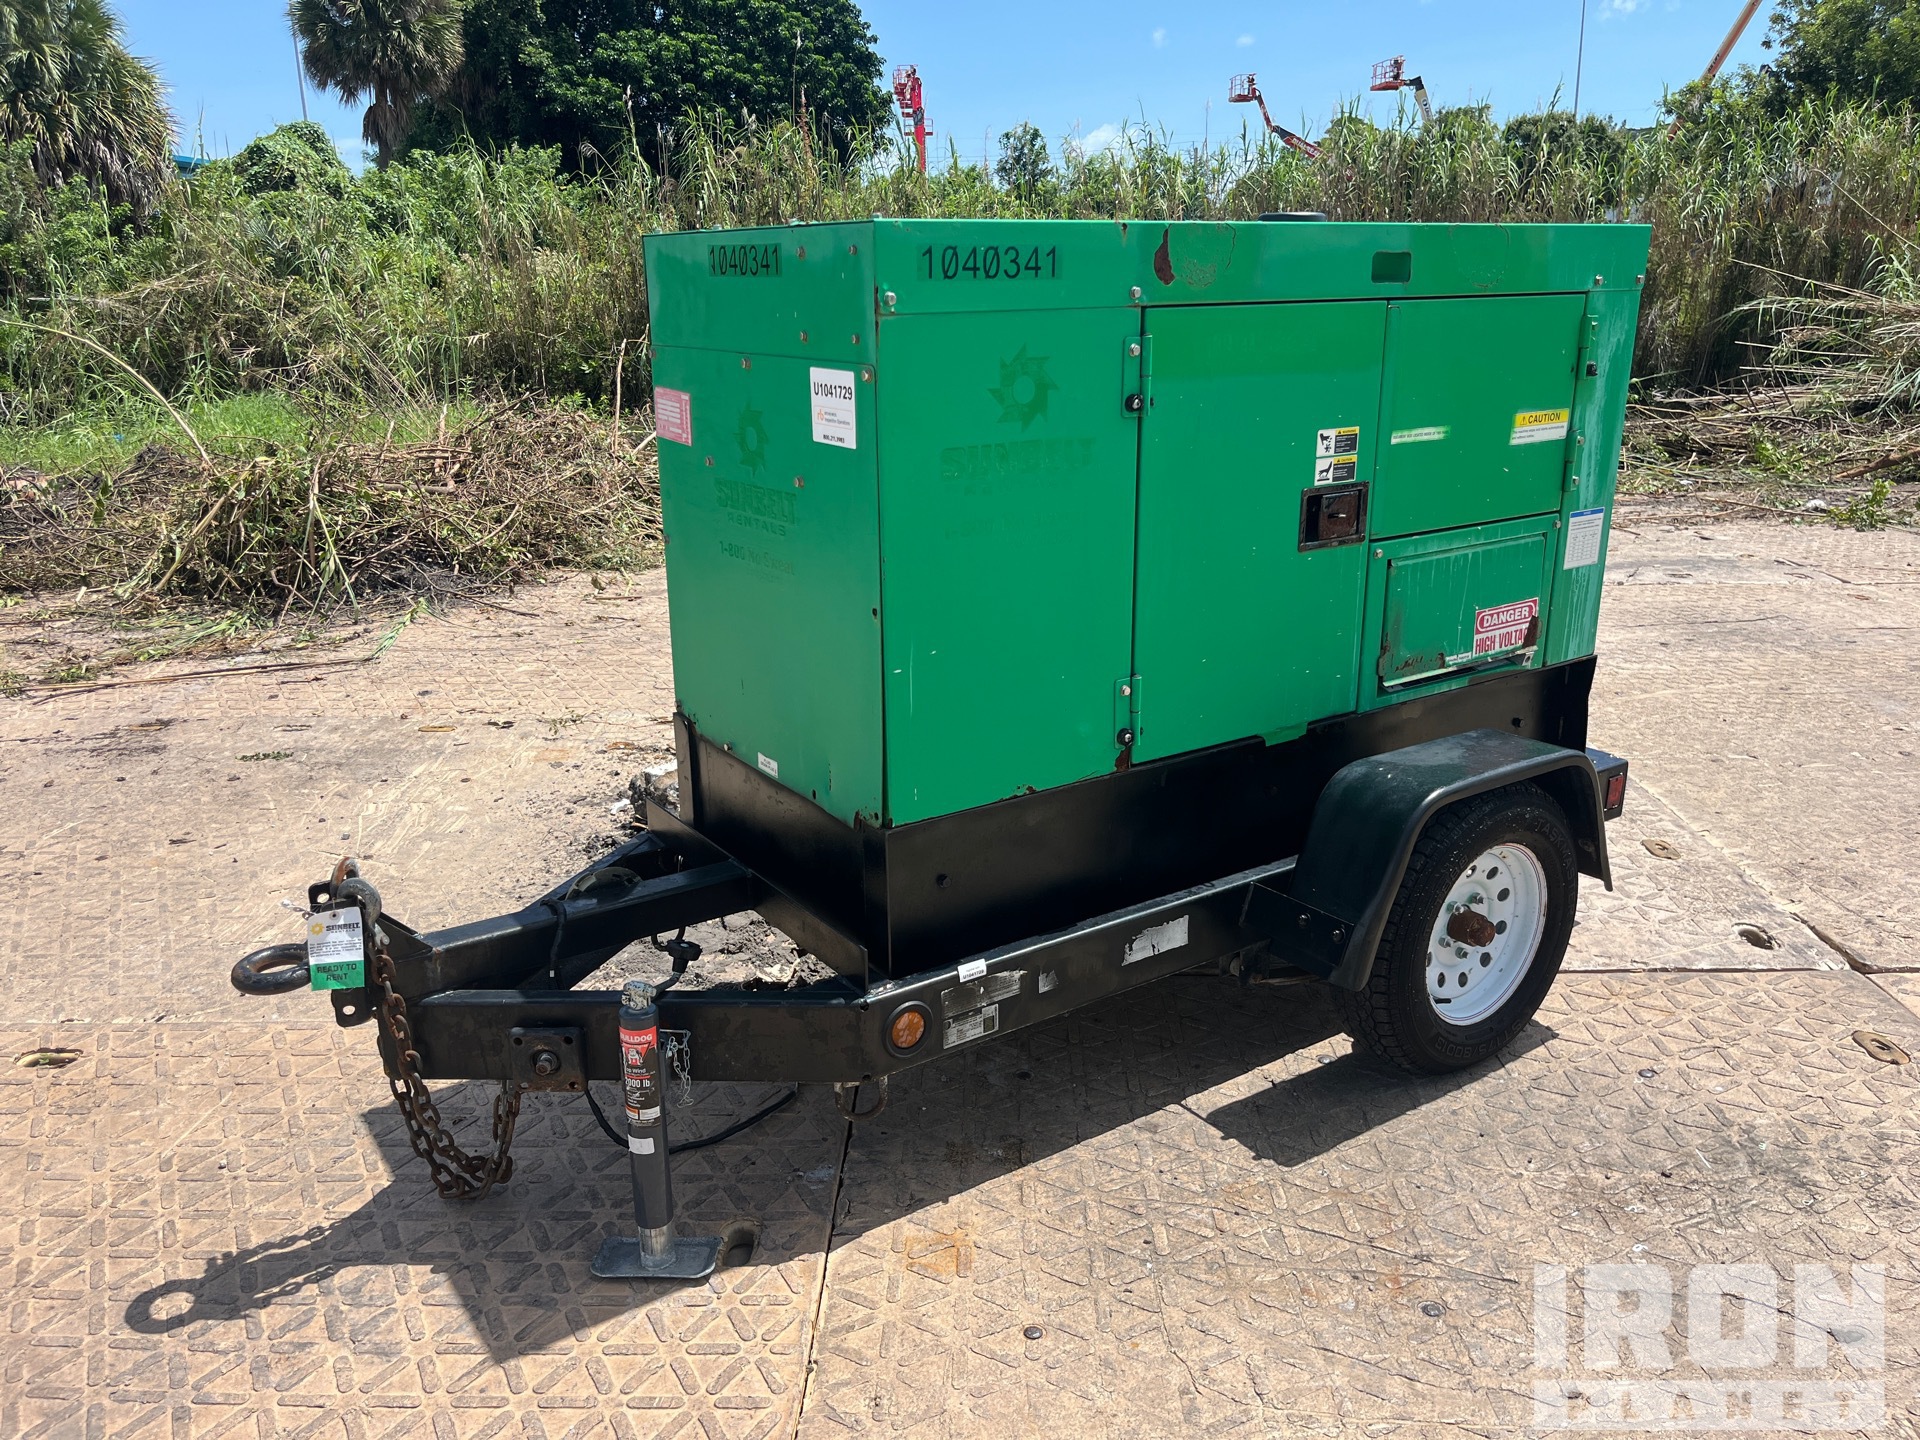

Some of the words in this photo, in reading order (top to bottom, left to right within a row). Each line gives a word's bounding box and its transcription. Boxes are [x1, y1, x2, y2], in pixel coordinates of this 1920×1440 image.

[709, 245, 781, 277] 1040341
[922, 246, 1058, 280] 1040341
[813, 382, 853, 400] U1041729
[1528, 412, 1561, 424] CAUTION
[1483, 606, 1530, 628] DANGER
[1475, 635, 1497, 655] HIGH
[1499, 628, 1528, 649] VOLTA
[325, 922, 361, 932] SUNBELT
[316, 964, 344, 974] READY
[346, 963, 357, 971] TO
[326, 973, 348, 982] RENT
